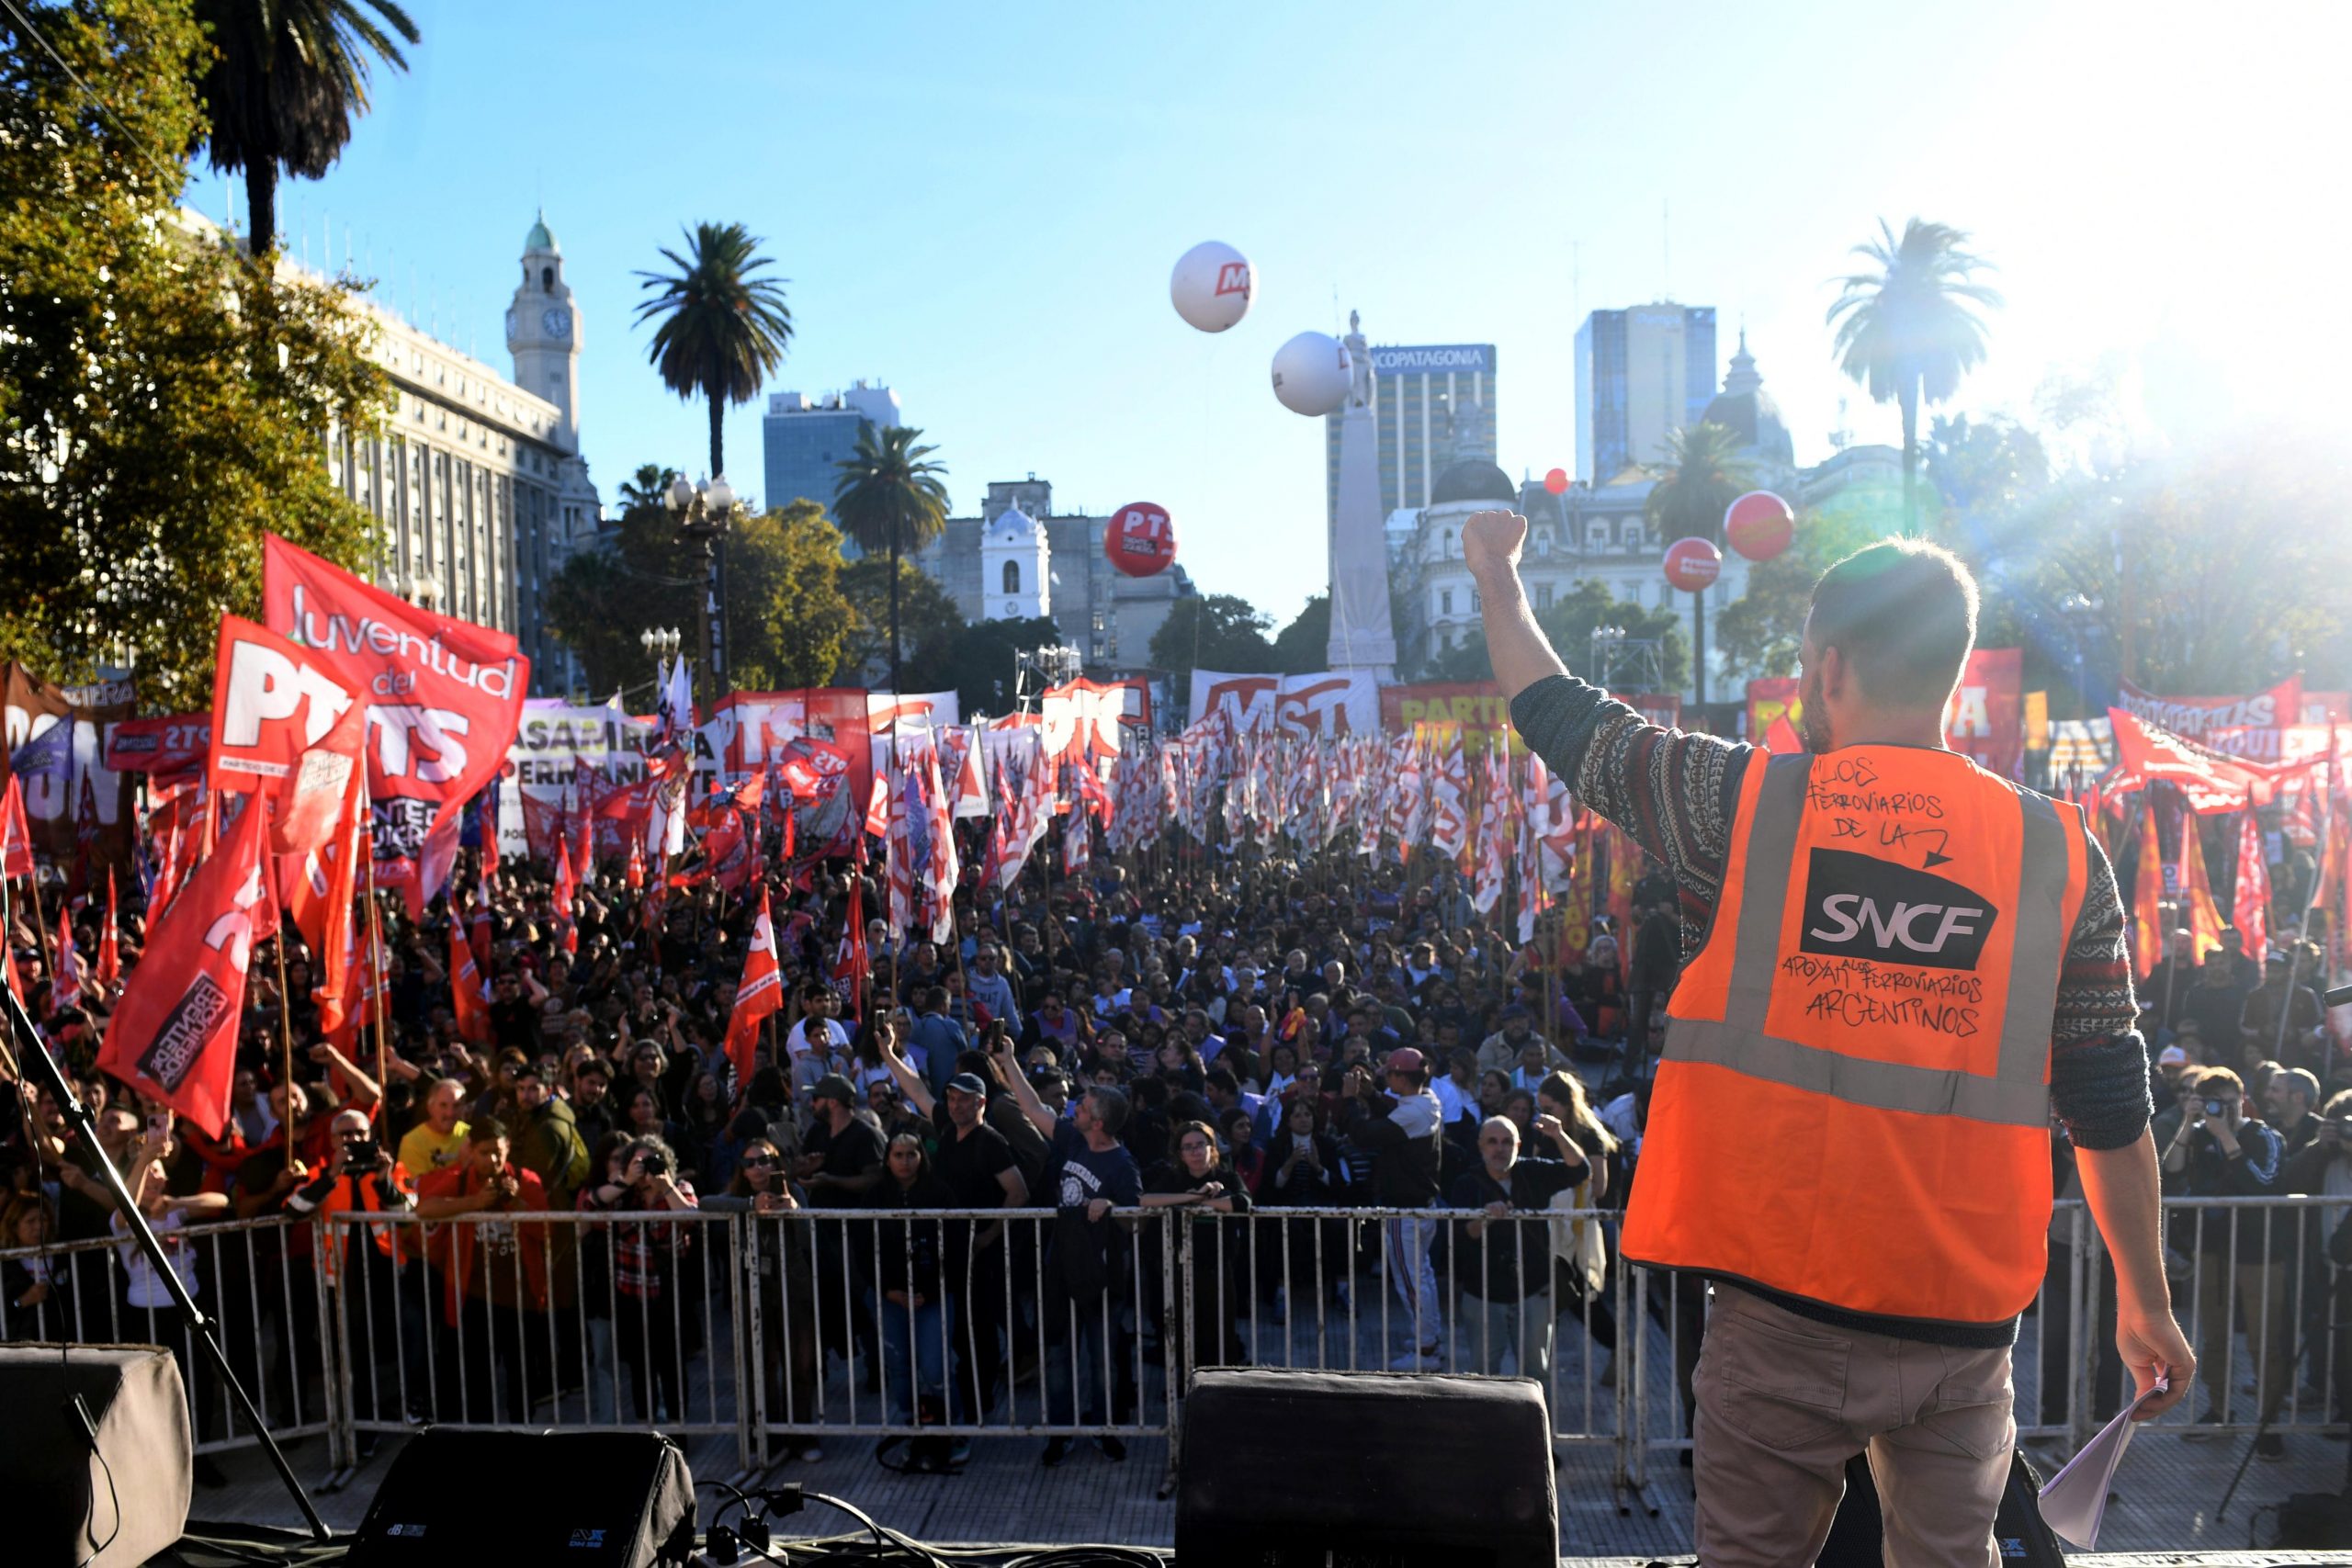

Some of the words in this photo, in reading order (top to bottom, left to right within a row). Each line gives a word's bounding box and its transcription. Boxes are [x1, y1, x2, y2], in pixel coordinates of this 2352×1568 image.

[292, 584, 516, 702] Juventud
[223, 638, 354, 748] PT
[372, 666, 415, 696] del
[1399, 696, 1510, 730] PARTI
[365, 704, 469, 783] TS
[1819, 757, 1878, 786] LOS
[1830, 818, 1866, 838] DE
[1880, 820, 1908, 849] LA
[1810, 893, 1983, 953] SNCF
[1805, 989, 1980, 1037] ARGENTINOS
